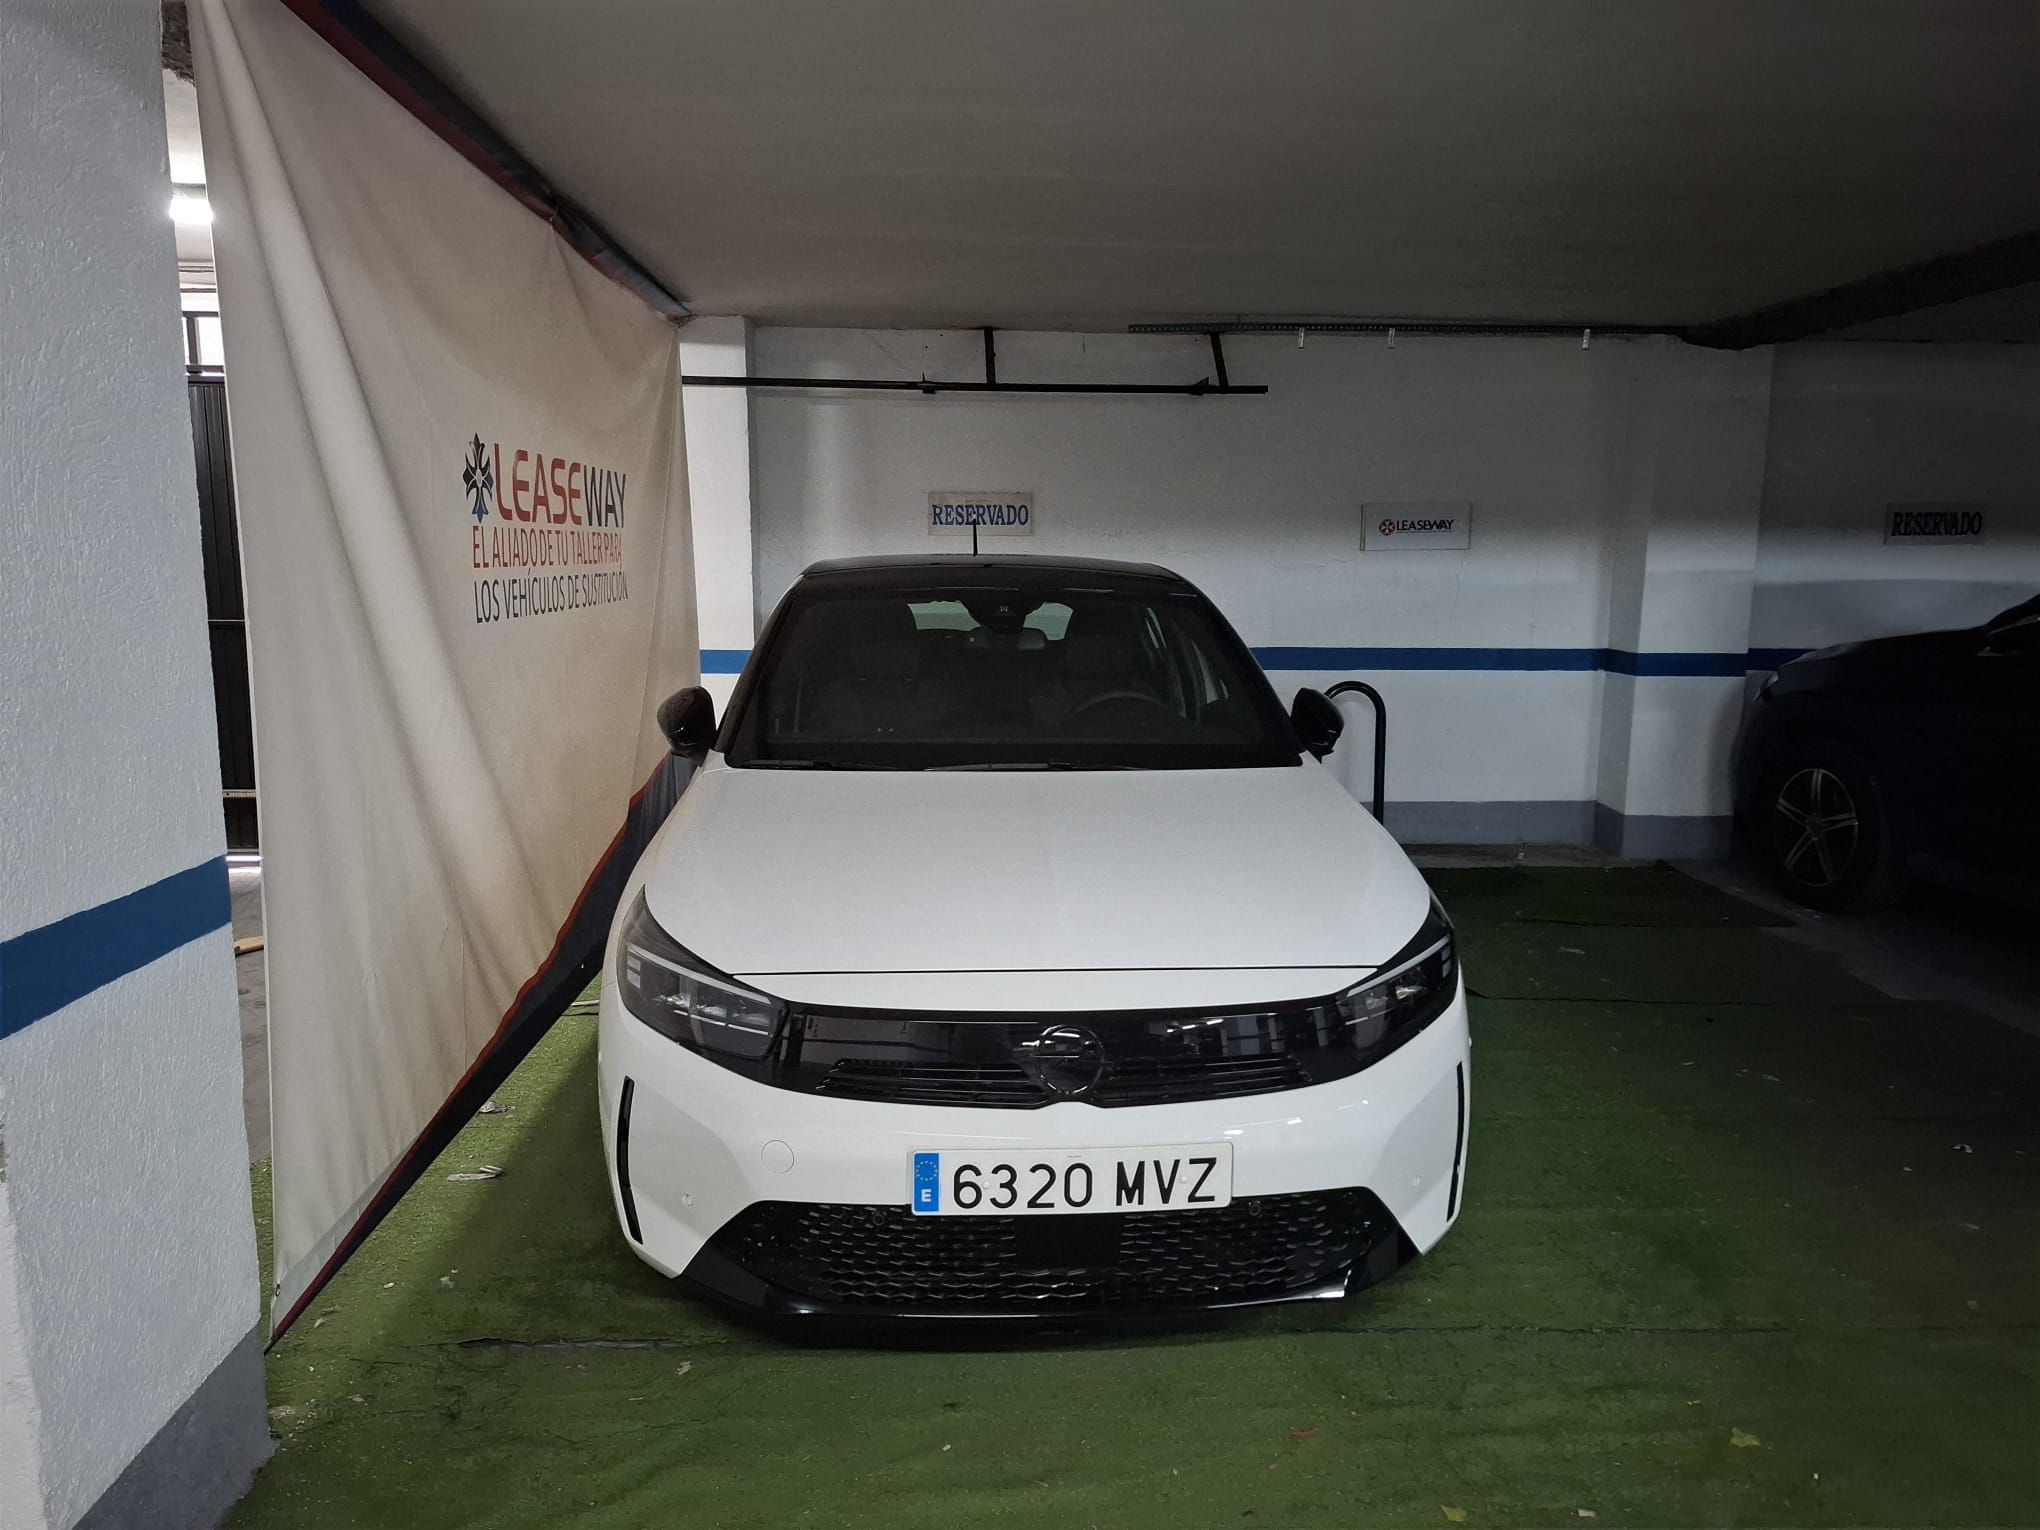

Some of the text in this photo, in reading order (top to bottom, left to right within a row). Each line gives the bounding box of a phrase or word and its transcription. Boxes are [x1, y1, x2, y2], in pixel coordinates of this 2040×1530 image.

[494, 443, 627, 529] LEASEWAY
[931, 504, 1029, 526] RESERVADO
[1396, 519, 1455, 531] LEASEWAY
[1891, 511, 1983, 537] RESERVADO
[472, 525, 623, 569] EL ALIADO DE TU TALLER PARA
[474, 567, 628, 624] LOS VEHÍCULOS DE SUSTITUCIÓN
[920, 1157, 1217, 1210] E 6320 MVZ
